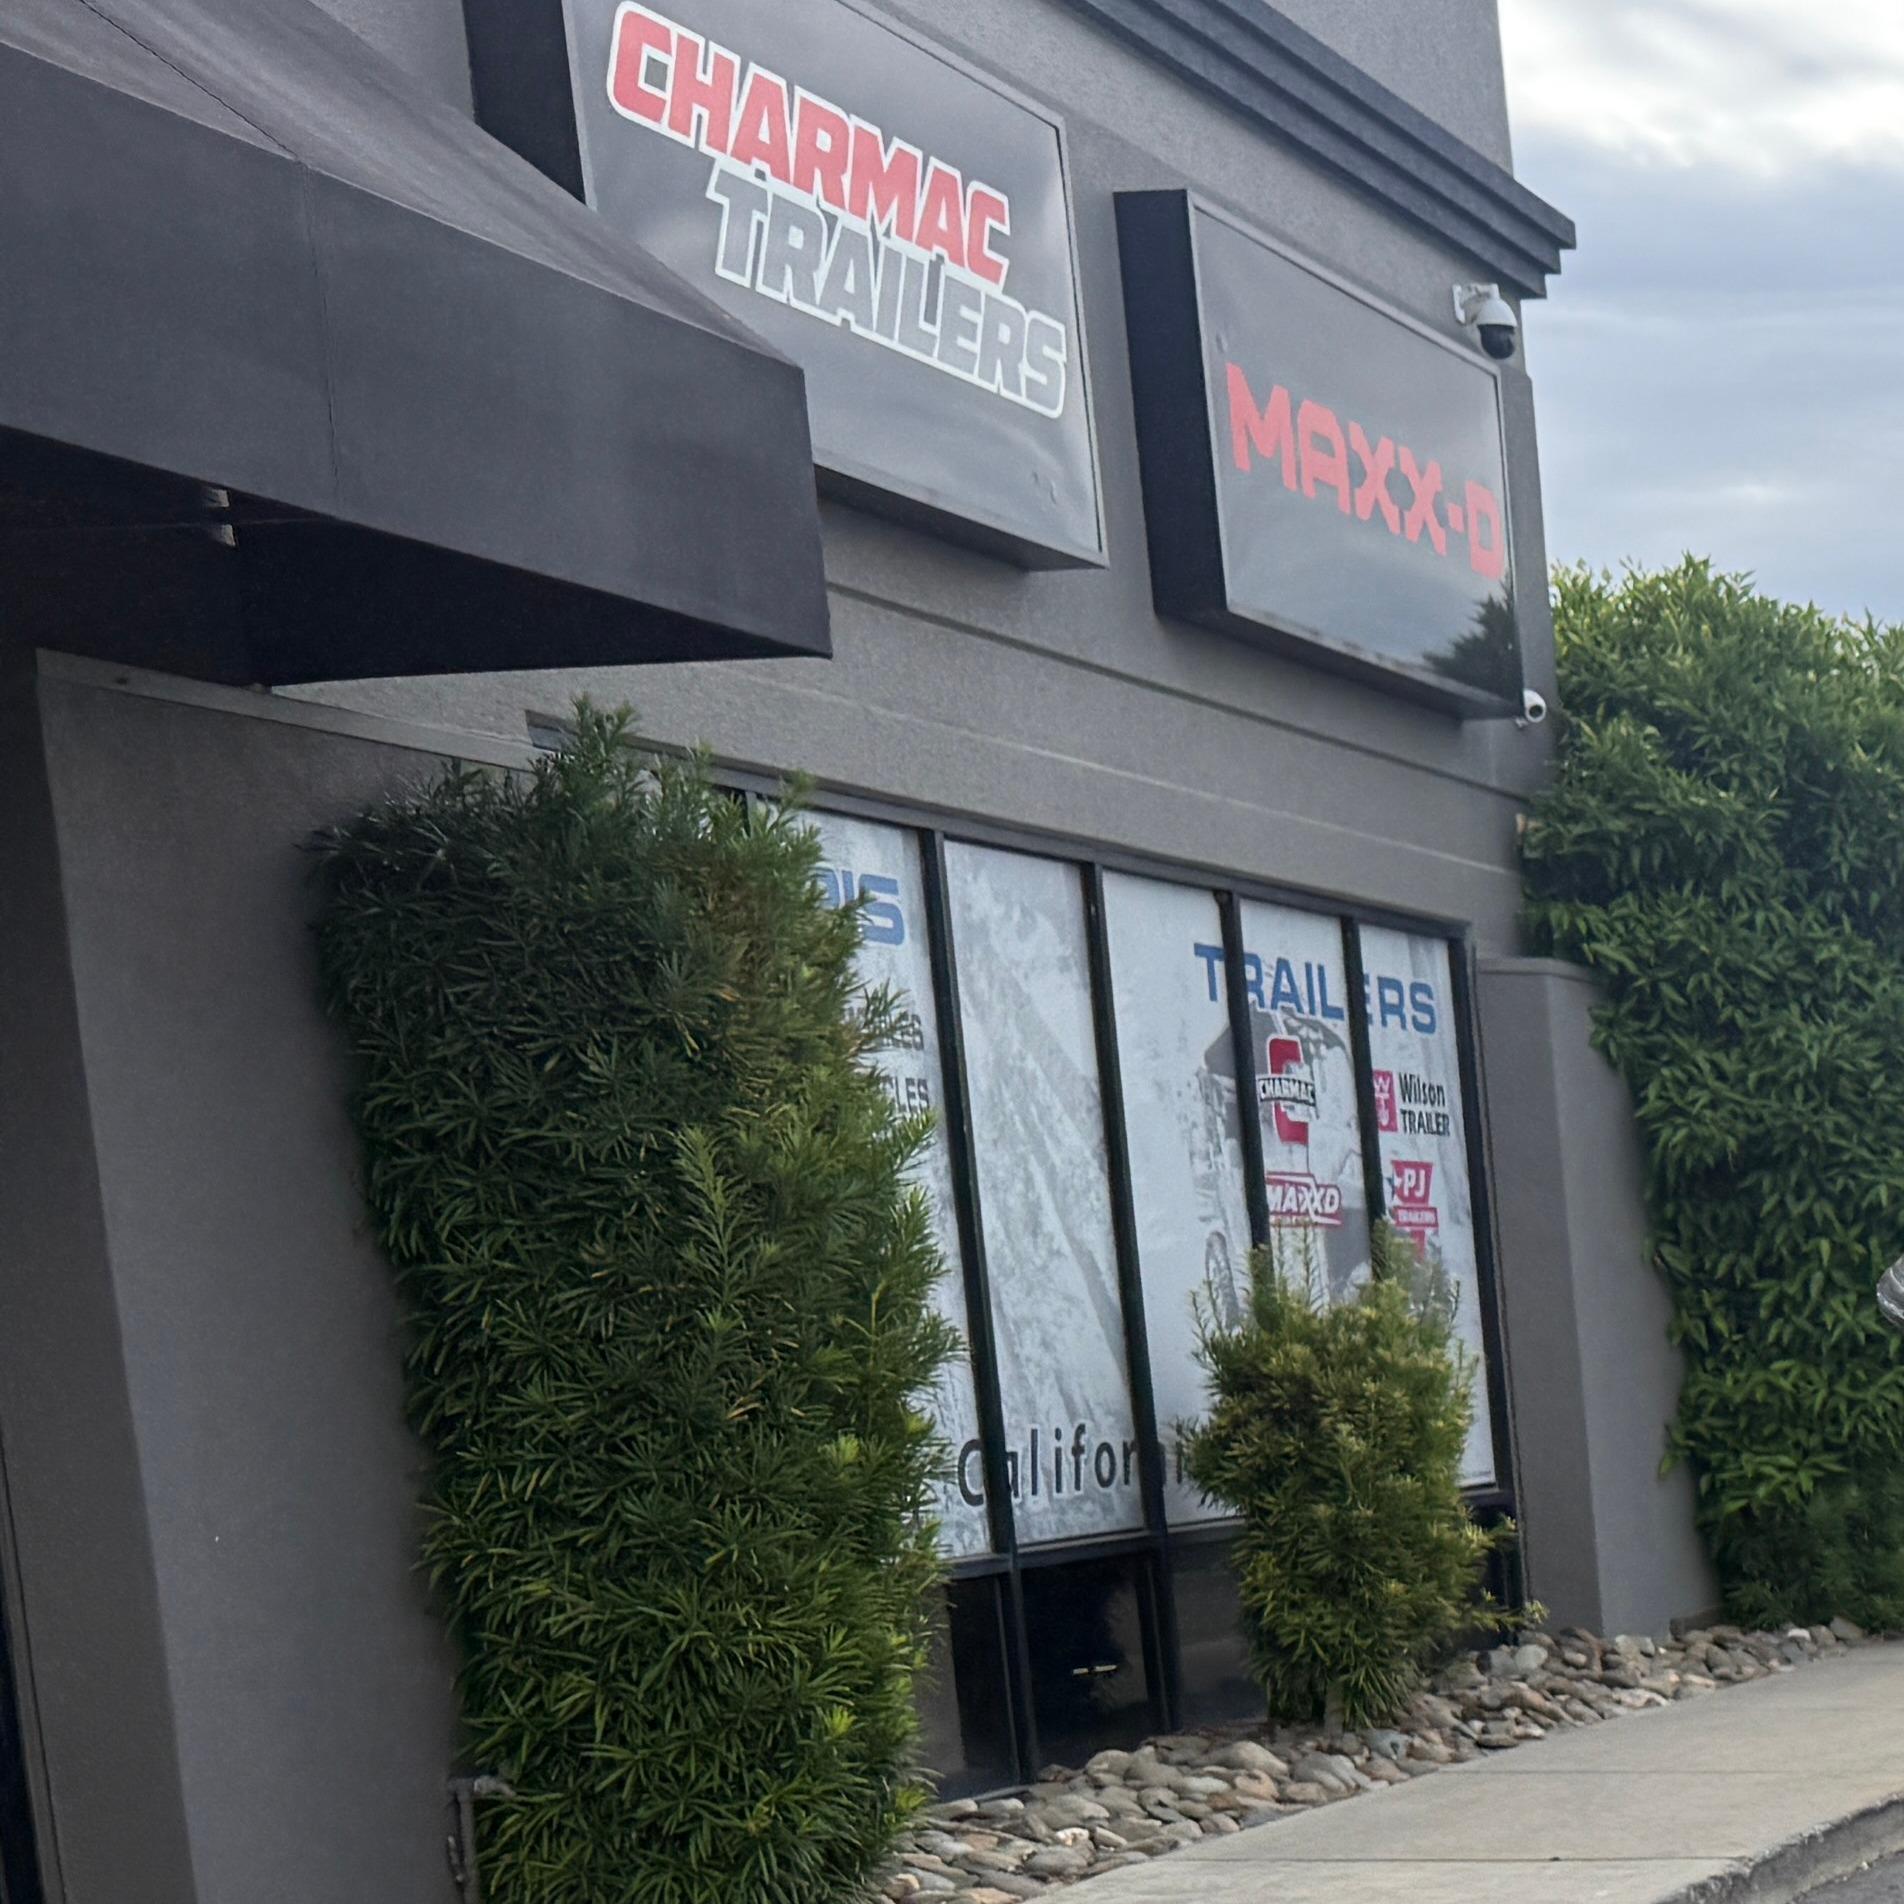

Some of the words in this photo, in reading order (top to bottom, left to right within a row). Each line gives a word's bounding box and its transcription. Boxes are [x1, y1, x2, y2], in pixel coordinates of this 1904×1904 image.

[608, 0, 1009, 290] CHARMAC
[706, 160, 1066, 418] TRAILERS
[1226, 361, 1504, 580] MAXX-D
[1400, 1071, 1446, 1105] Wilson
[1400, 1109, 1450, 1136] TRAILER
[1403, 1168, 1426, 1198] PJ
